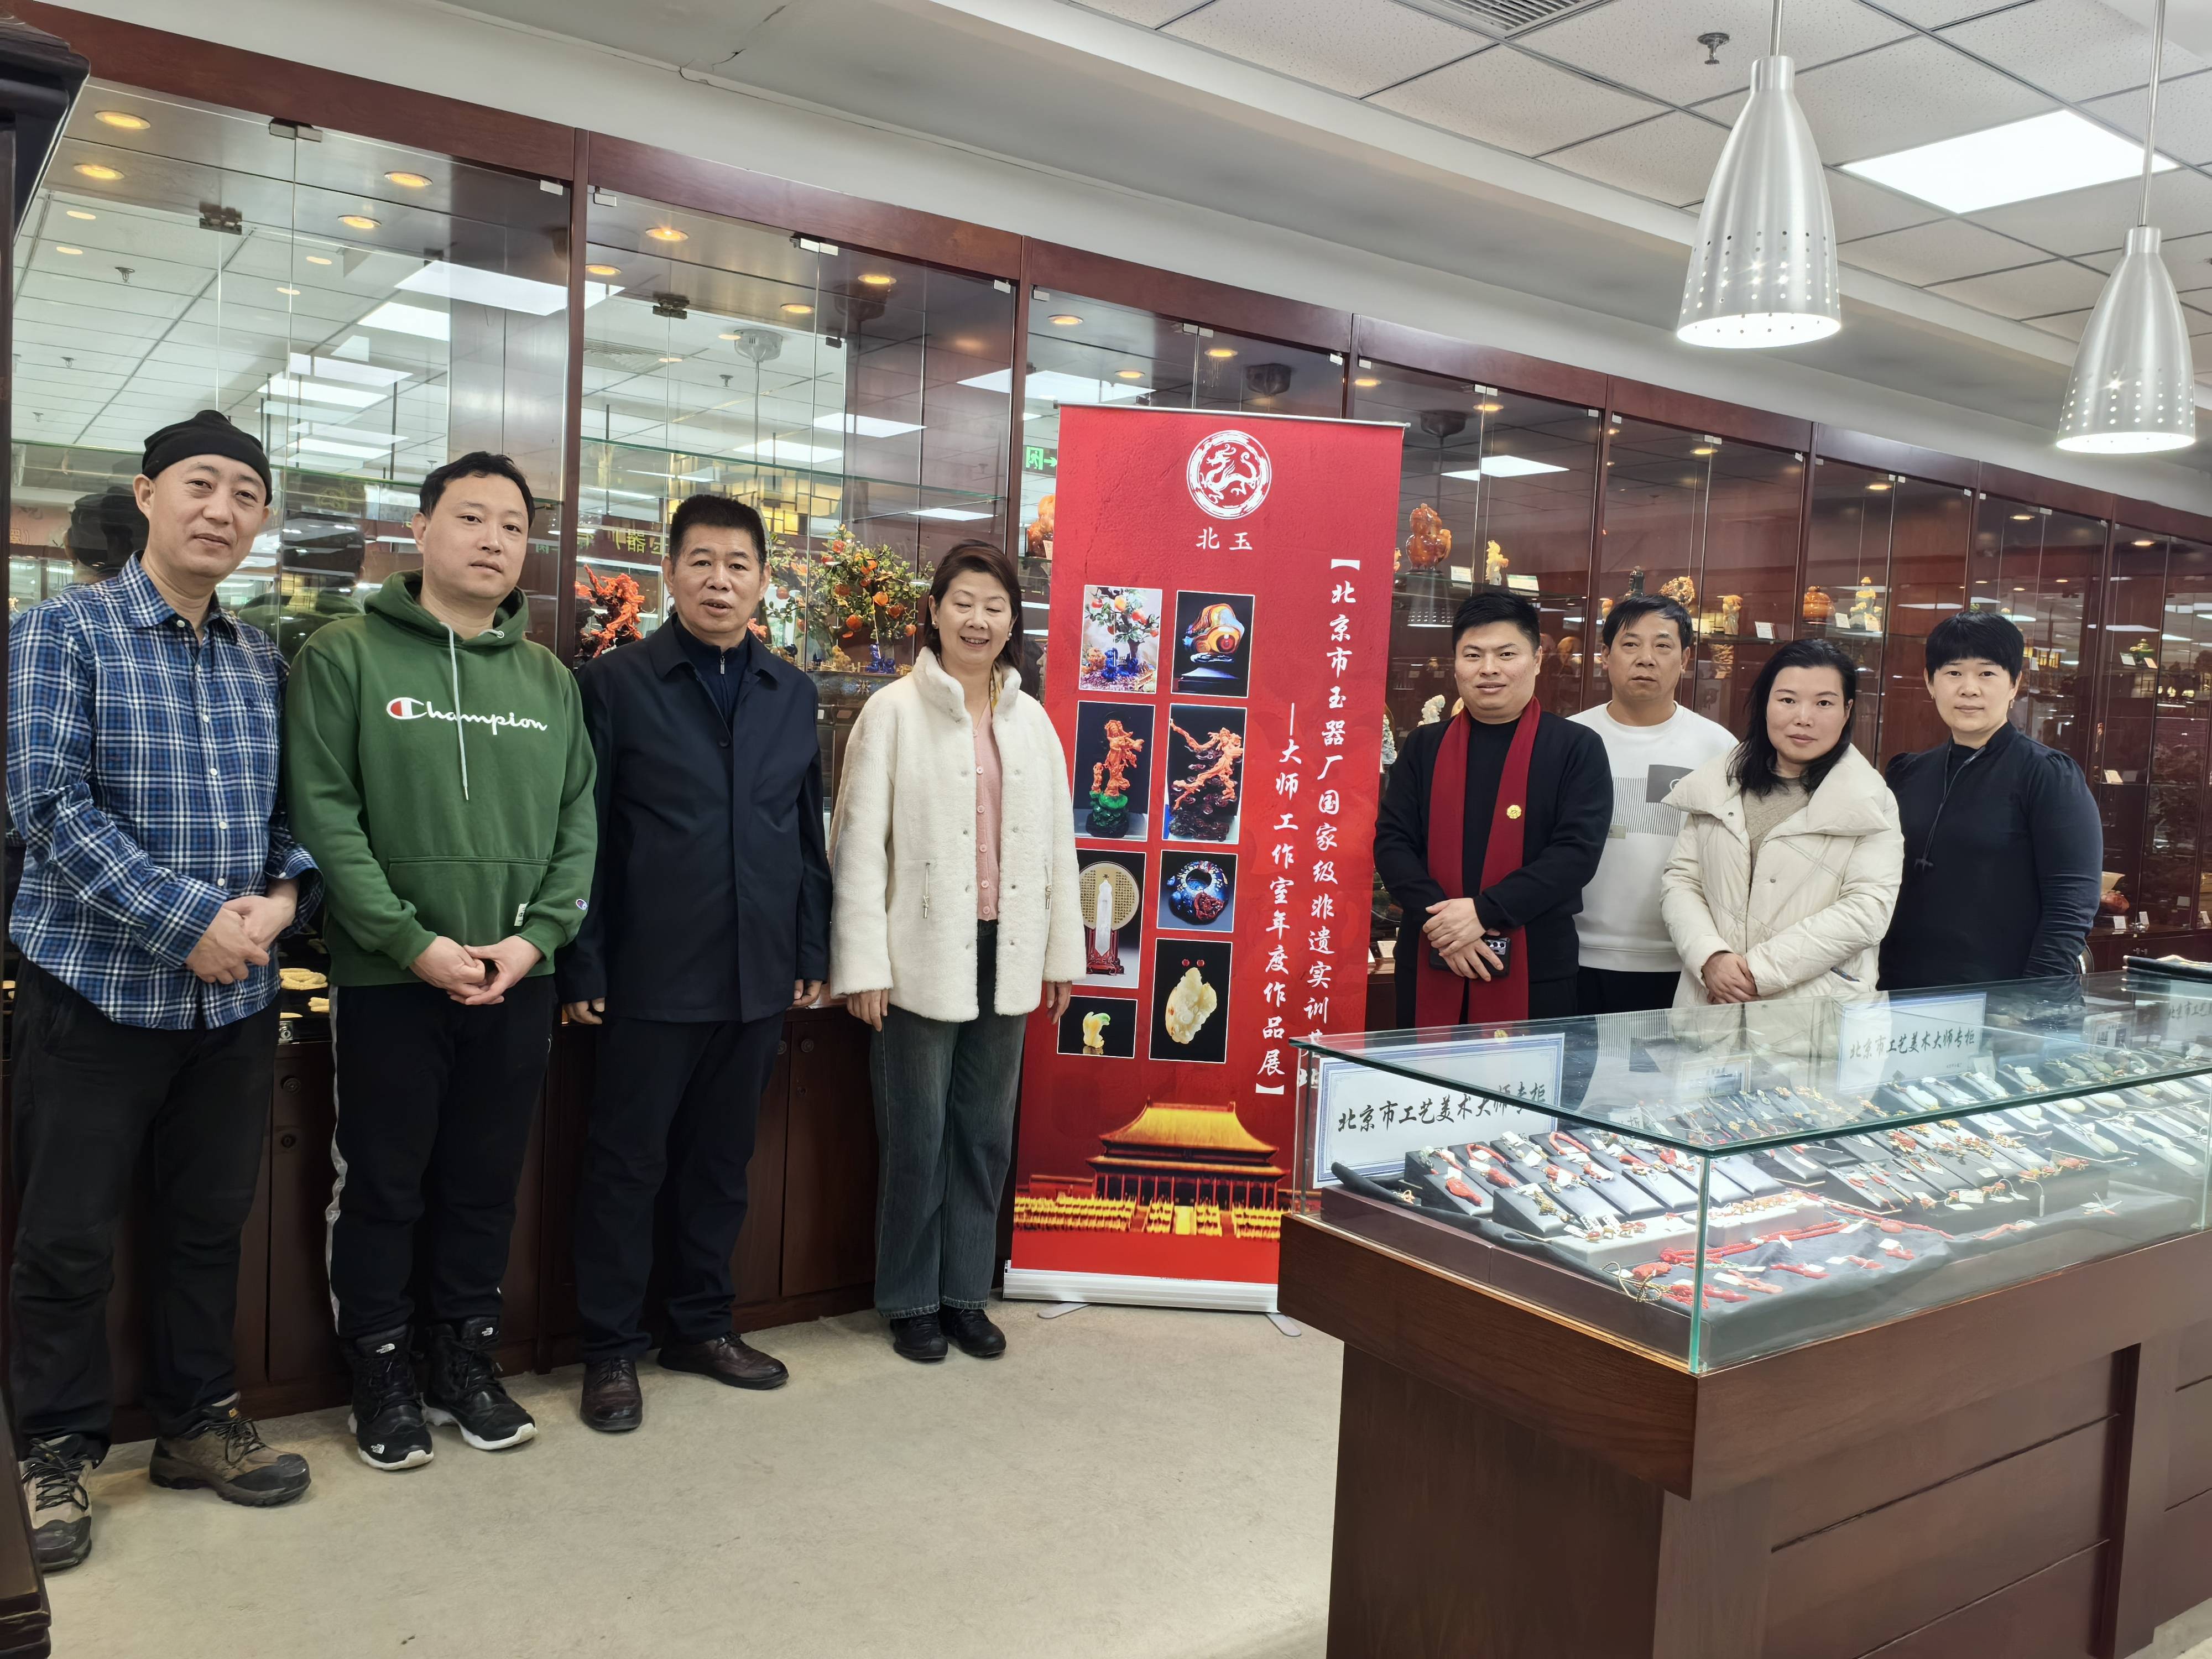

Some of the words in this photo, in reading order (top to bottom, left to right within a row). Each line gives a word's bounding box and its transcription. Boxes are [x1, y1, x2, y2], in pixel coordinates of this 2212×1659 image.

[1195, 527, 1253, 551] 北玉
[386, 697, 547, 735] Champion
[1850, 1026, 1975, 1059] 北京市工艺美术大师专柜
[1338, 1081, 1546, 1132] 北京市工艺美术大师专柜
